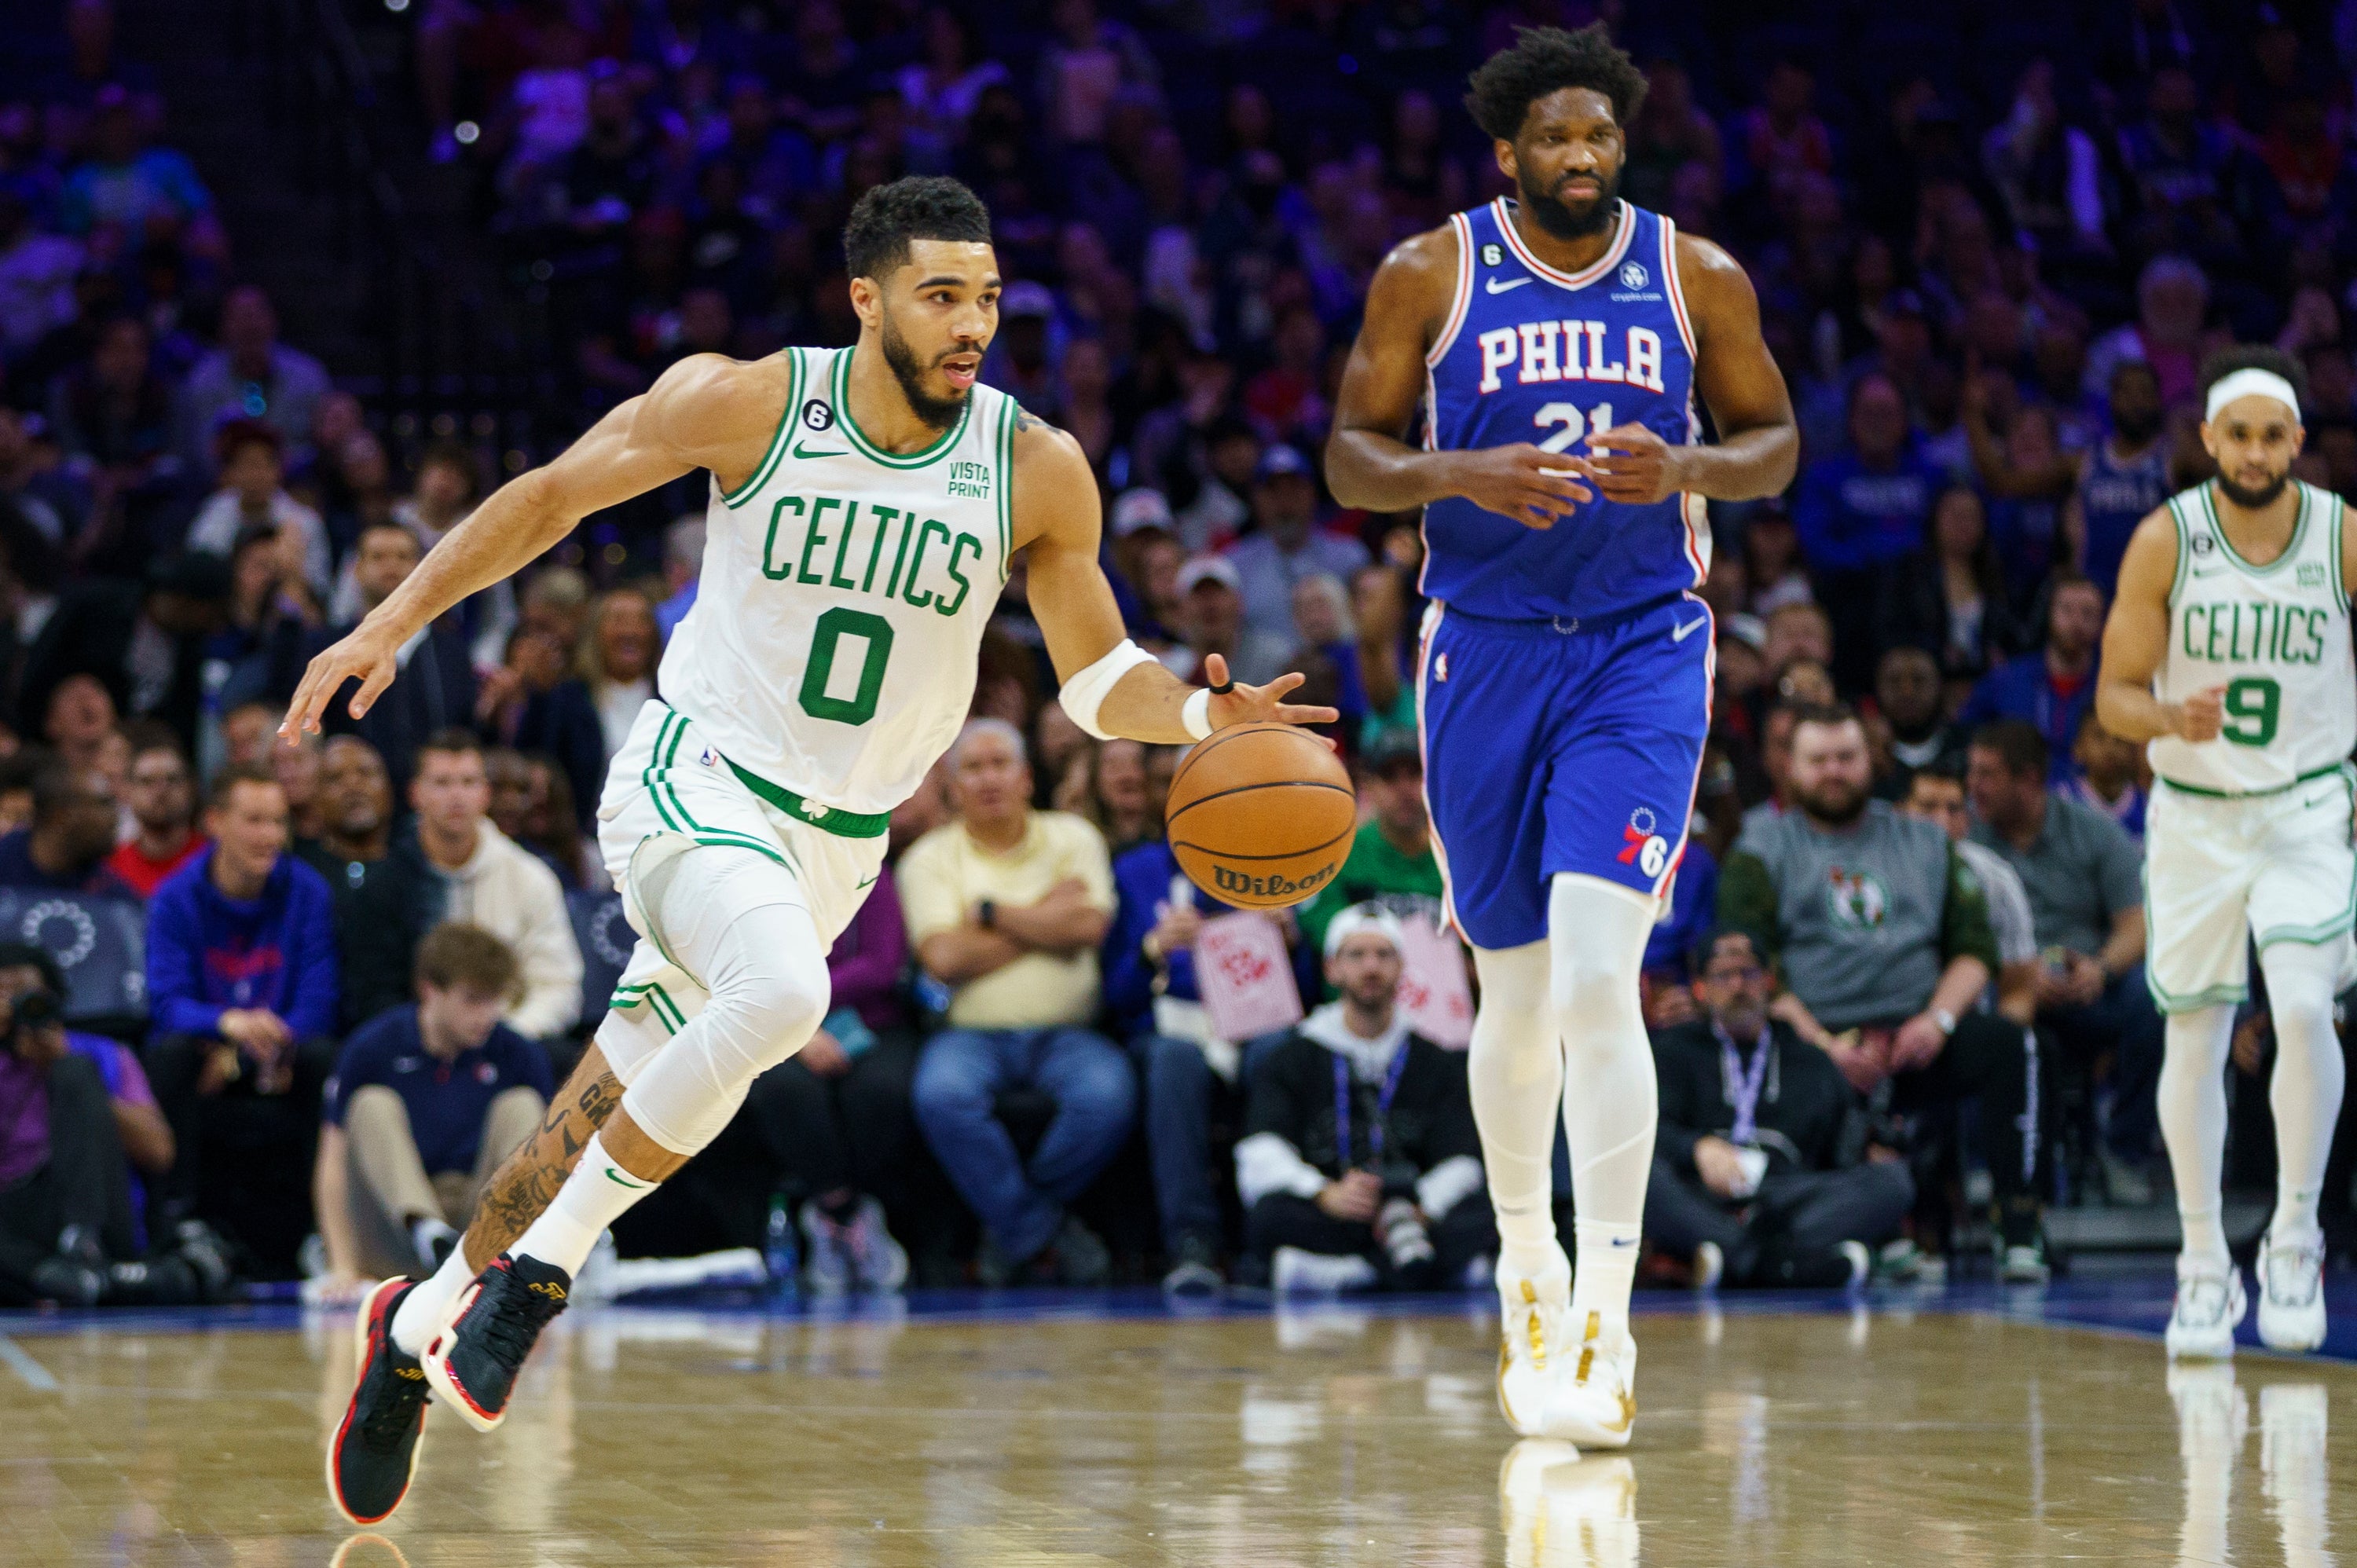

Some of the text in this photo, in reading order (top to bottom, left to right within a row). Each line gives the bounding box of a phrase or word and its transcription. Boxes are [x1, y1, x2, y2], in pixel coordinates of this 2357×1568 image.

[1483, 244, 1502, 266] 6
[1478, 320, 1664, 394] PHILA
[807, 404, 828, 428] 6
[1534, 401, 1613, 478] 21
[948, 481, 991, 499] PRINT
[949, 462, 990, 485] VISTA
[762, 496, 983, 617] CELTICS
[2184, 602, 2328, 665] CELTICS
[798, 606, 895, 727] 0
[2222, 676, 2281, 748] 9
[1213, 863, 1336, 896] Wilson
[1616, 822, 1668, 878] 76
